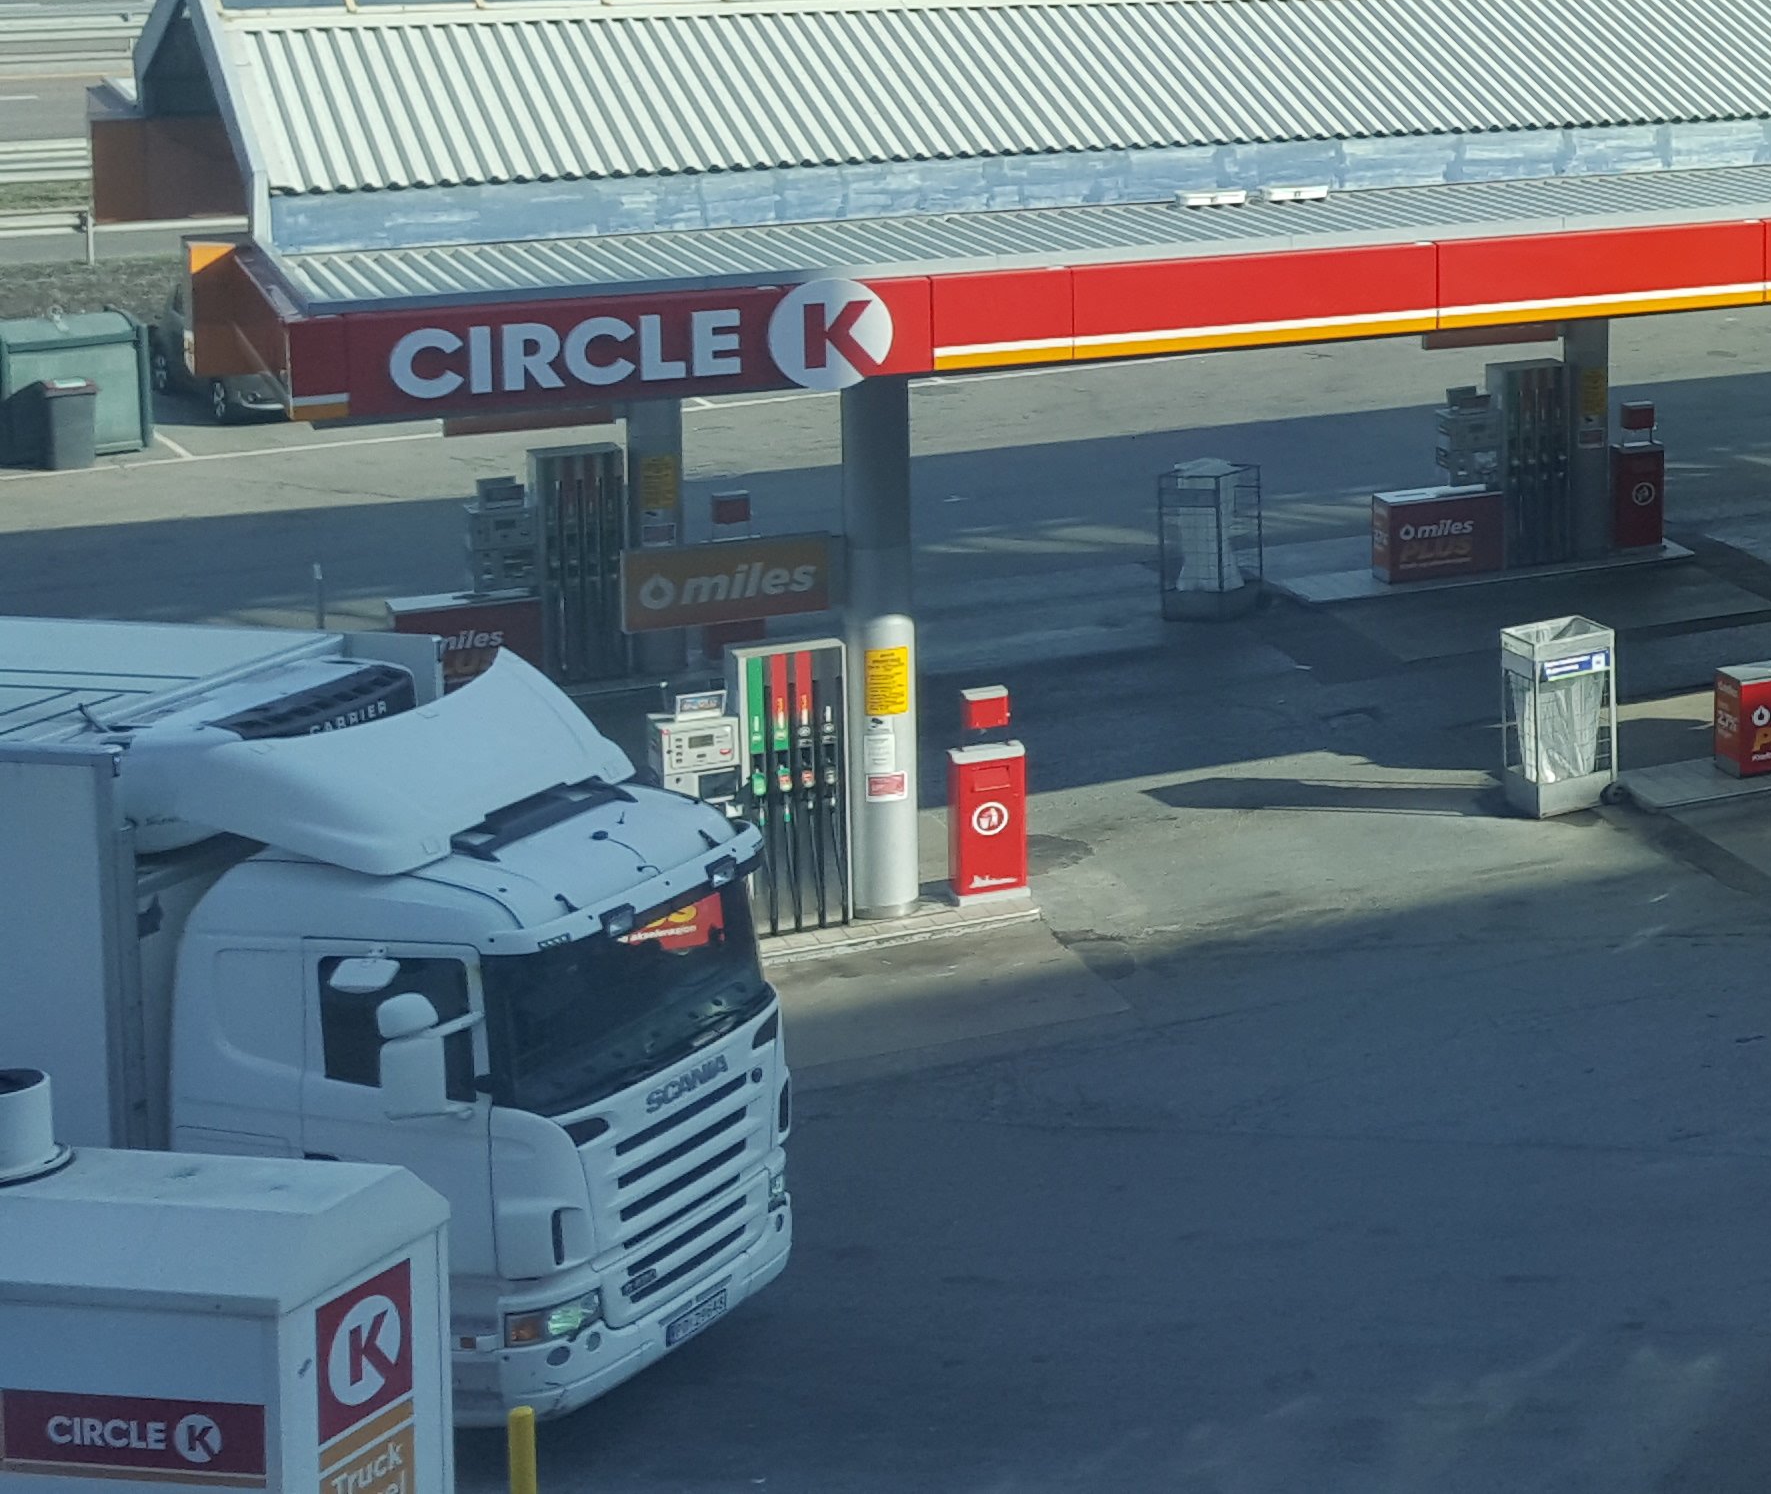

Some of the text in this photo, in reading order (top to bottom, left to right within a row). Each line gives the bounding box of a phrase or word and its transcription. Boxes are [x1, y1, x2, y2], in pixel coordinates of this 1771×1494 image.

[389, 307, 742, 399] CIRCLE
[1416, 519, 1475, 539] miles
[681, 561, 817, 605] miles
[646, 1054, 729, 1114] SCANIA
[48, 1415, 168, 1451] CIRCLE
[331, 1441, 404, 1494] Truck
